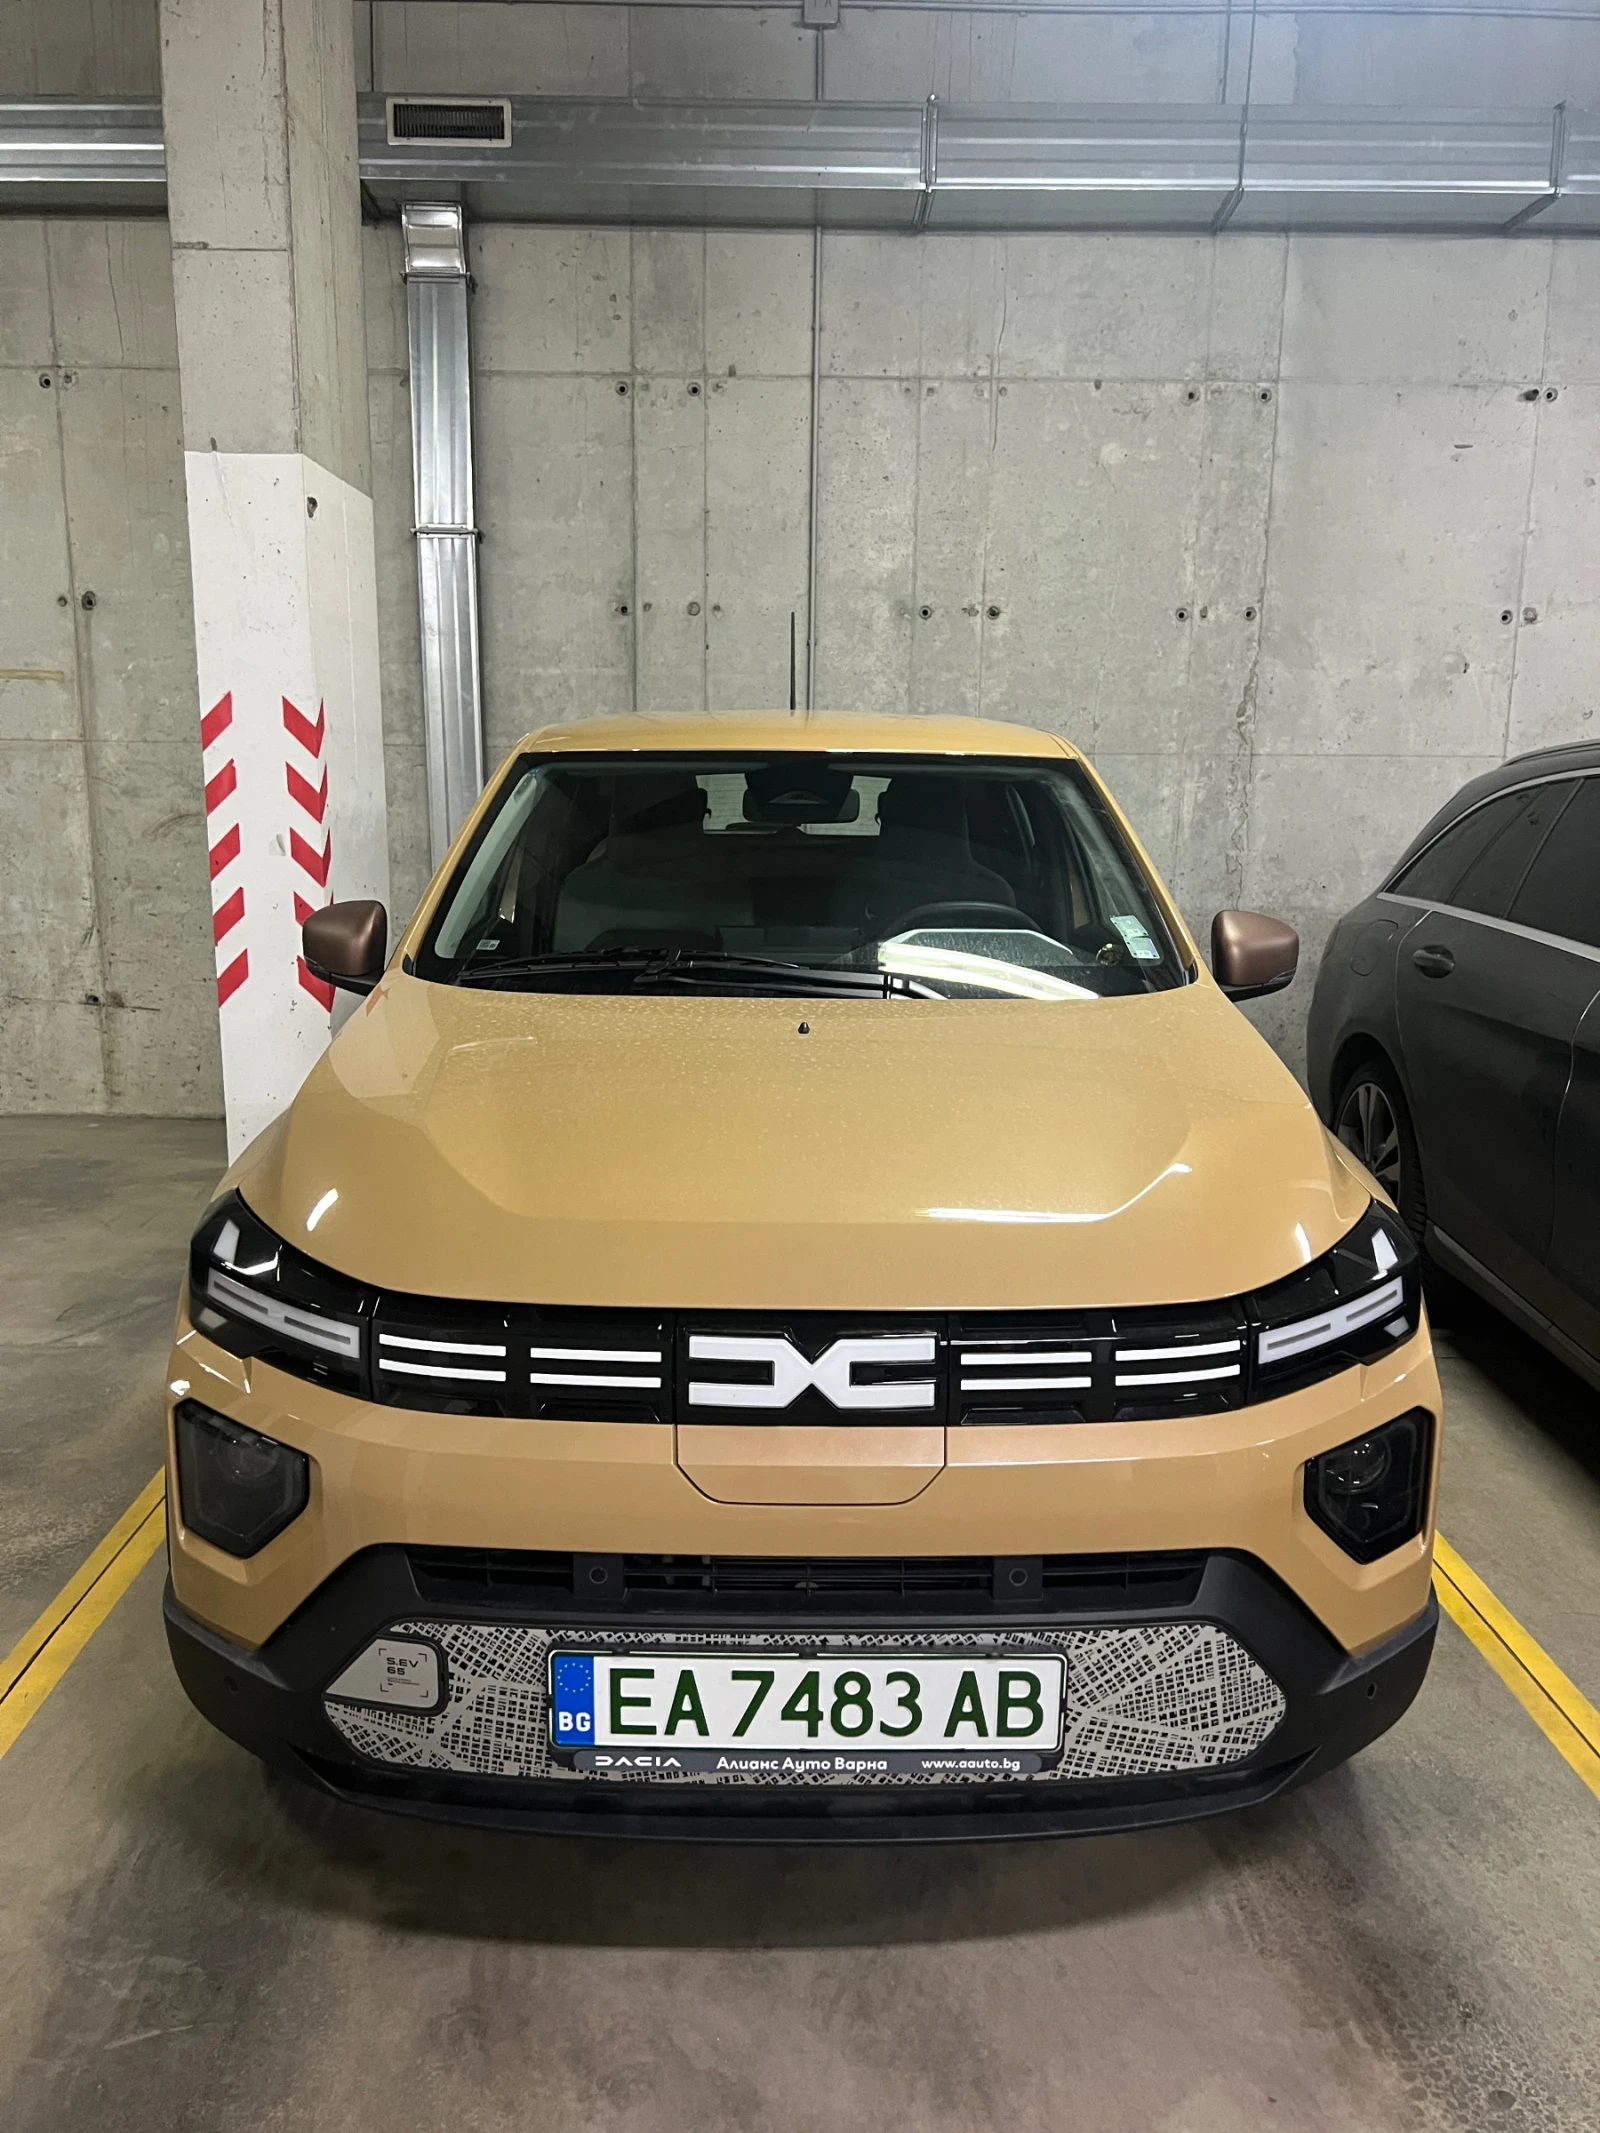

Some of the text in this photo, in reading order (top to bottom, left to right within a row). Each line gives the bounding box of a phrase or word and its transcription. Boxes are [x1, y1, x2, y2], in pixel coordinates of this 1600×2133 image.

[610, 1668, 1044, 1738] EA 7483 AB
[558, 1711, 592, 1732] BG
[595, 1756, 682, 1767] DACIA
[716, 1756, 779, 1770] Алианс
[834, 1757, 888, 1771] Варна
[921, 1757, 1021, 1772] www.aauto.bg
